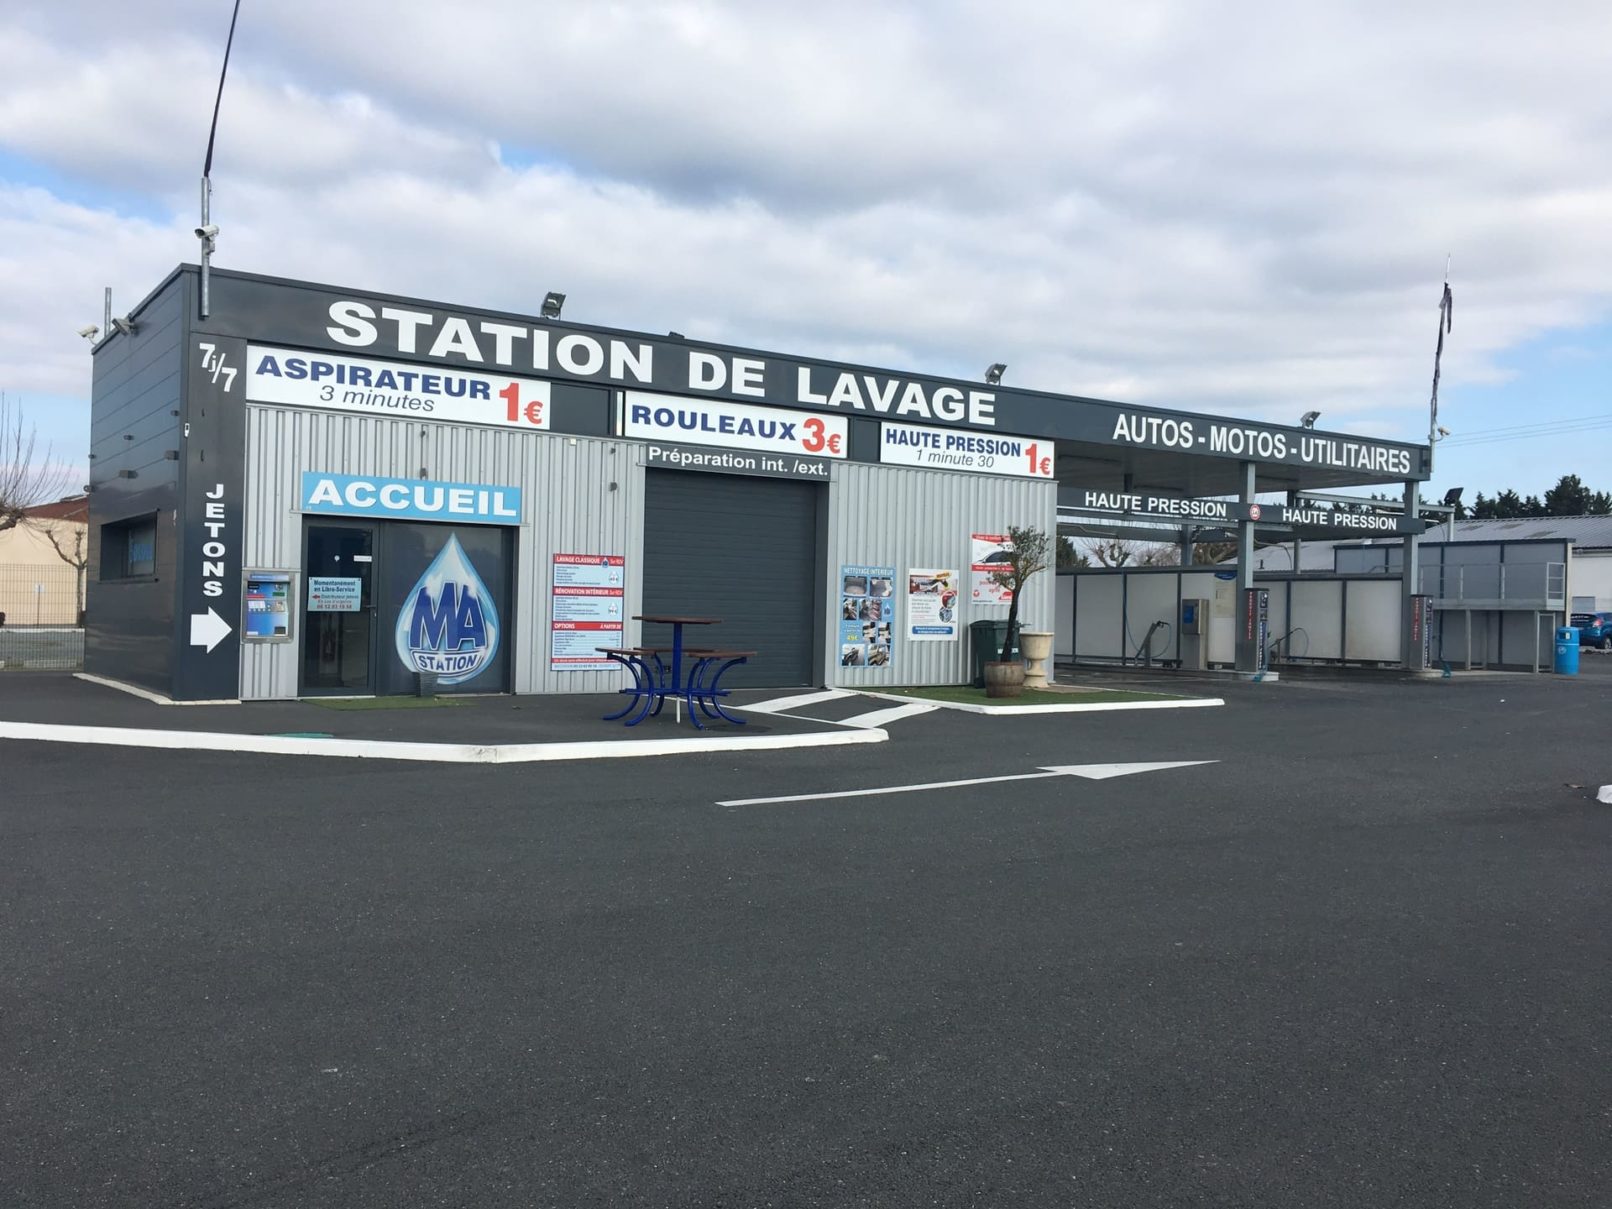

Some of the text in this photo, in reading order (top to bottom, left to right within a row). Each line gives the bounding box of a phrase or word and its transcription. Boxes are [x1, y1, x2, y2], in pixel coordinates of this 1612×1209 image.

[199, 342, 238, 392] 7j/7
[326, 301, 995, 426] STATION DE LAVAGE
[256, 355, 543, 424] ASPIRATEUR 1€
[319, 385, 435, 412] 3 minutes
[632, 405, 841, 454] ROULEAUX 3€
[1112, 414, 1194, 448] AUTOS
[1210, 425, 1287, 459] MOTOS
[1301, 438, 1411, 474] UTILITAIRES
[649, 446, 828, 476] Préparation int. /ext.
[886, 428, 1051, 475] HAUTE PRESSION 1€
[916, 449, 995, 468] 1 minute 30
[308, 479, 517, 517] ACCUEIL
[1085, 491, 1227, 517] HAUTE PRESSION
[202, 483, 226, 597] JETONS
[1282, 508, 1397, 531] HAUTE PRESSION
[844, 567, 869, 575] NETTOYAGE
[409, 581, 487, 650] MA
[418, 654, 477, 672] STATION
